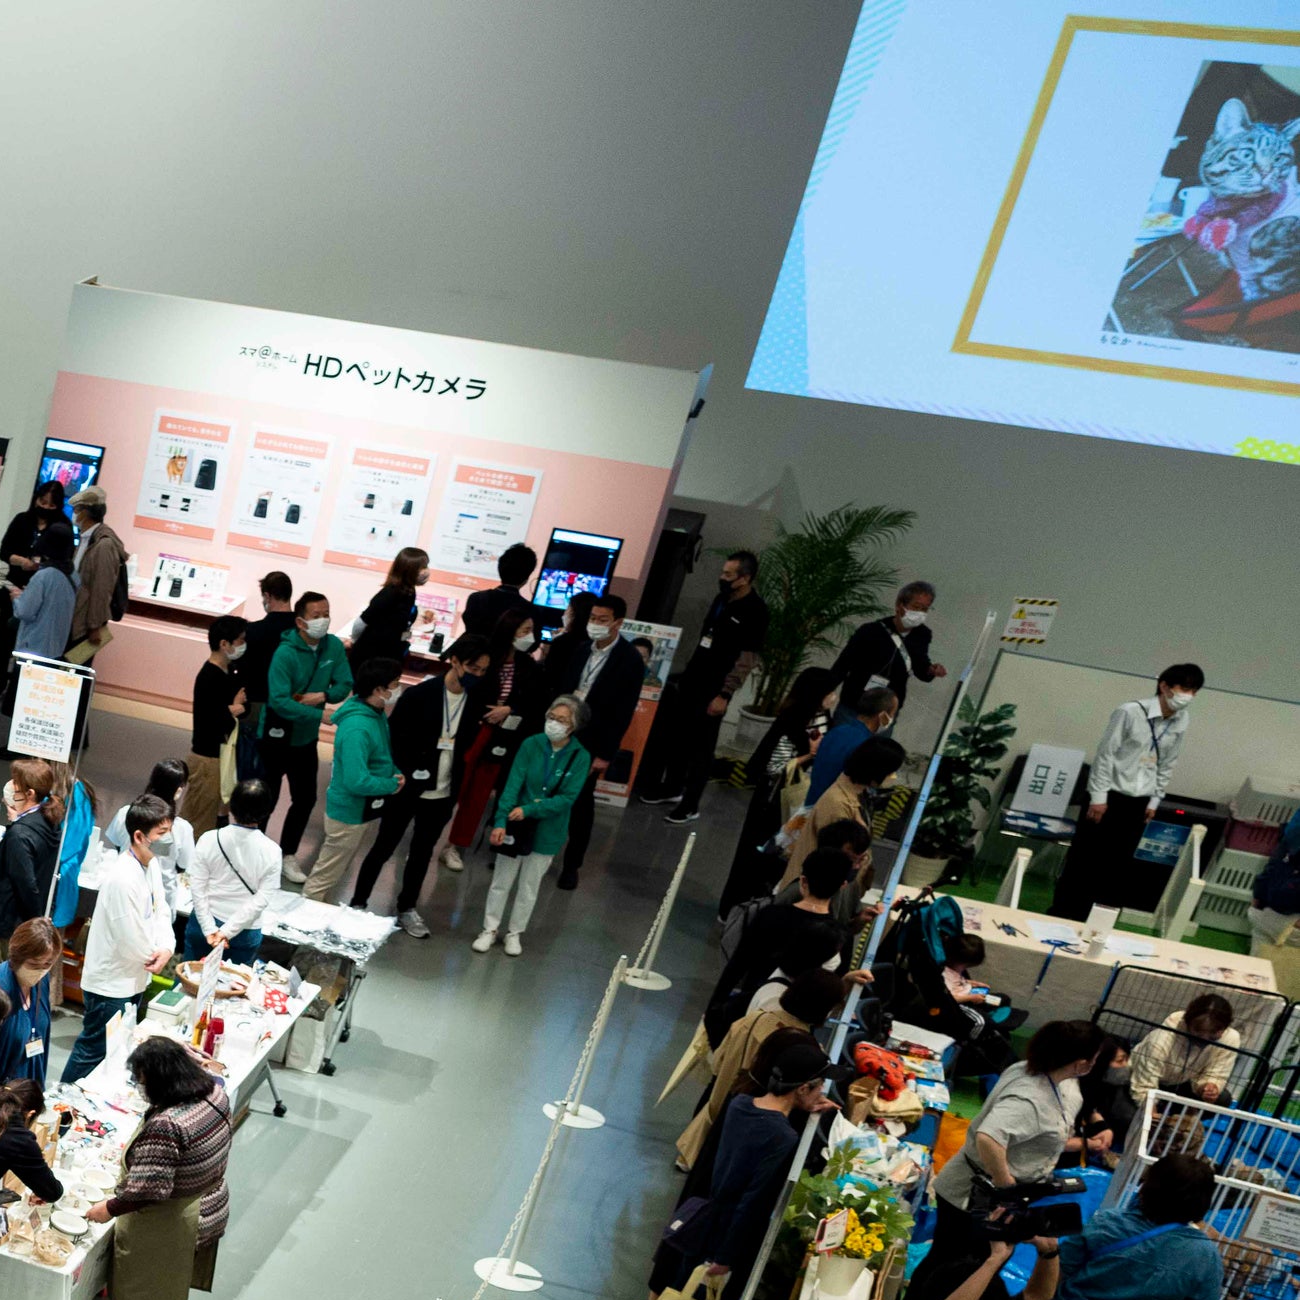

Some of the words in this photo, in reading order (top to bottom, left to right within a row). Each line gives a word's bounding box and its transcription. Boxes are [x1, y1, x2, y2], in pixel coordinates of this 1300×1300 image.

[302, 353, 487, 400] HDペットカメラ
[1028, 764, 1052, 795] 出口
[1052, 769, 1068, 795] EXIT
